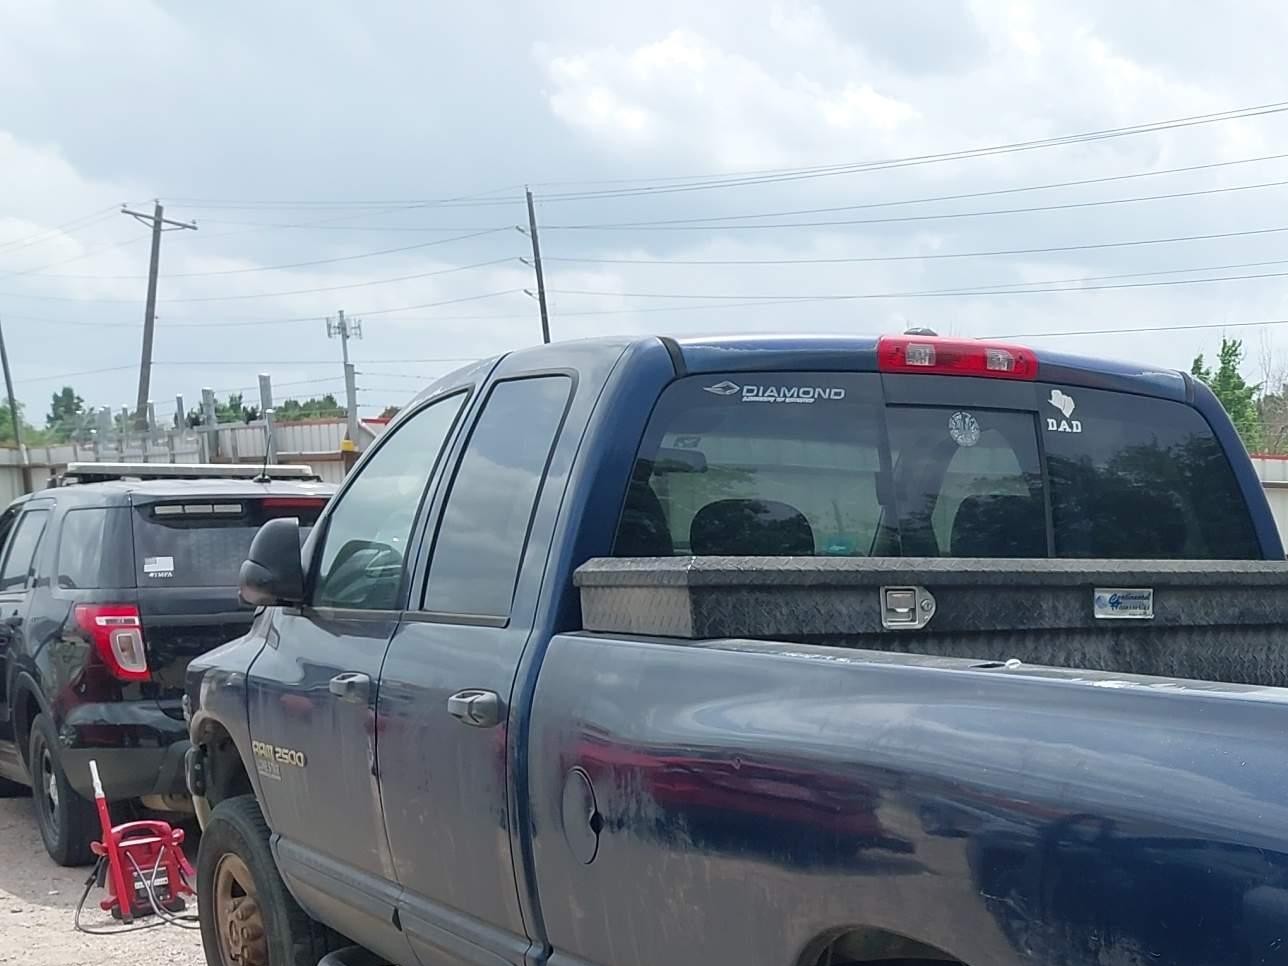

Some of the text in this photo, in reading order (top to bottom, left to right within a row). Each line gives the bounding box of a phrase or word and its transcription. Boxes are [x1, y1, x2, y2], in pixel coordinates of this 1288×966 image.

[742, 385, 846, 401] DIAMOND
[1046, 418, 1082, 433] DAD
[251, 740, 274, 761] RAM
[274, 747, 305, 768] 2500
